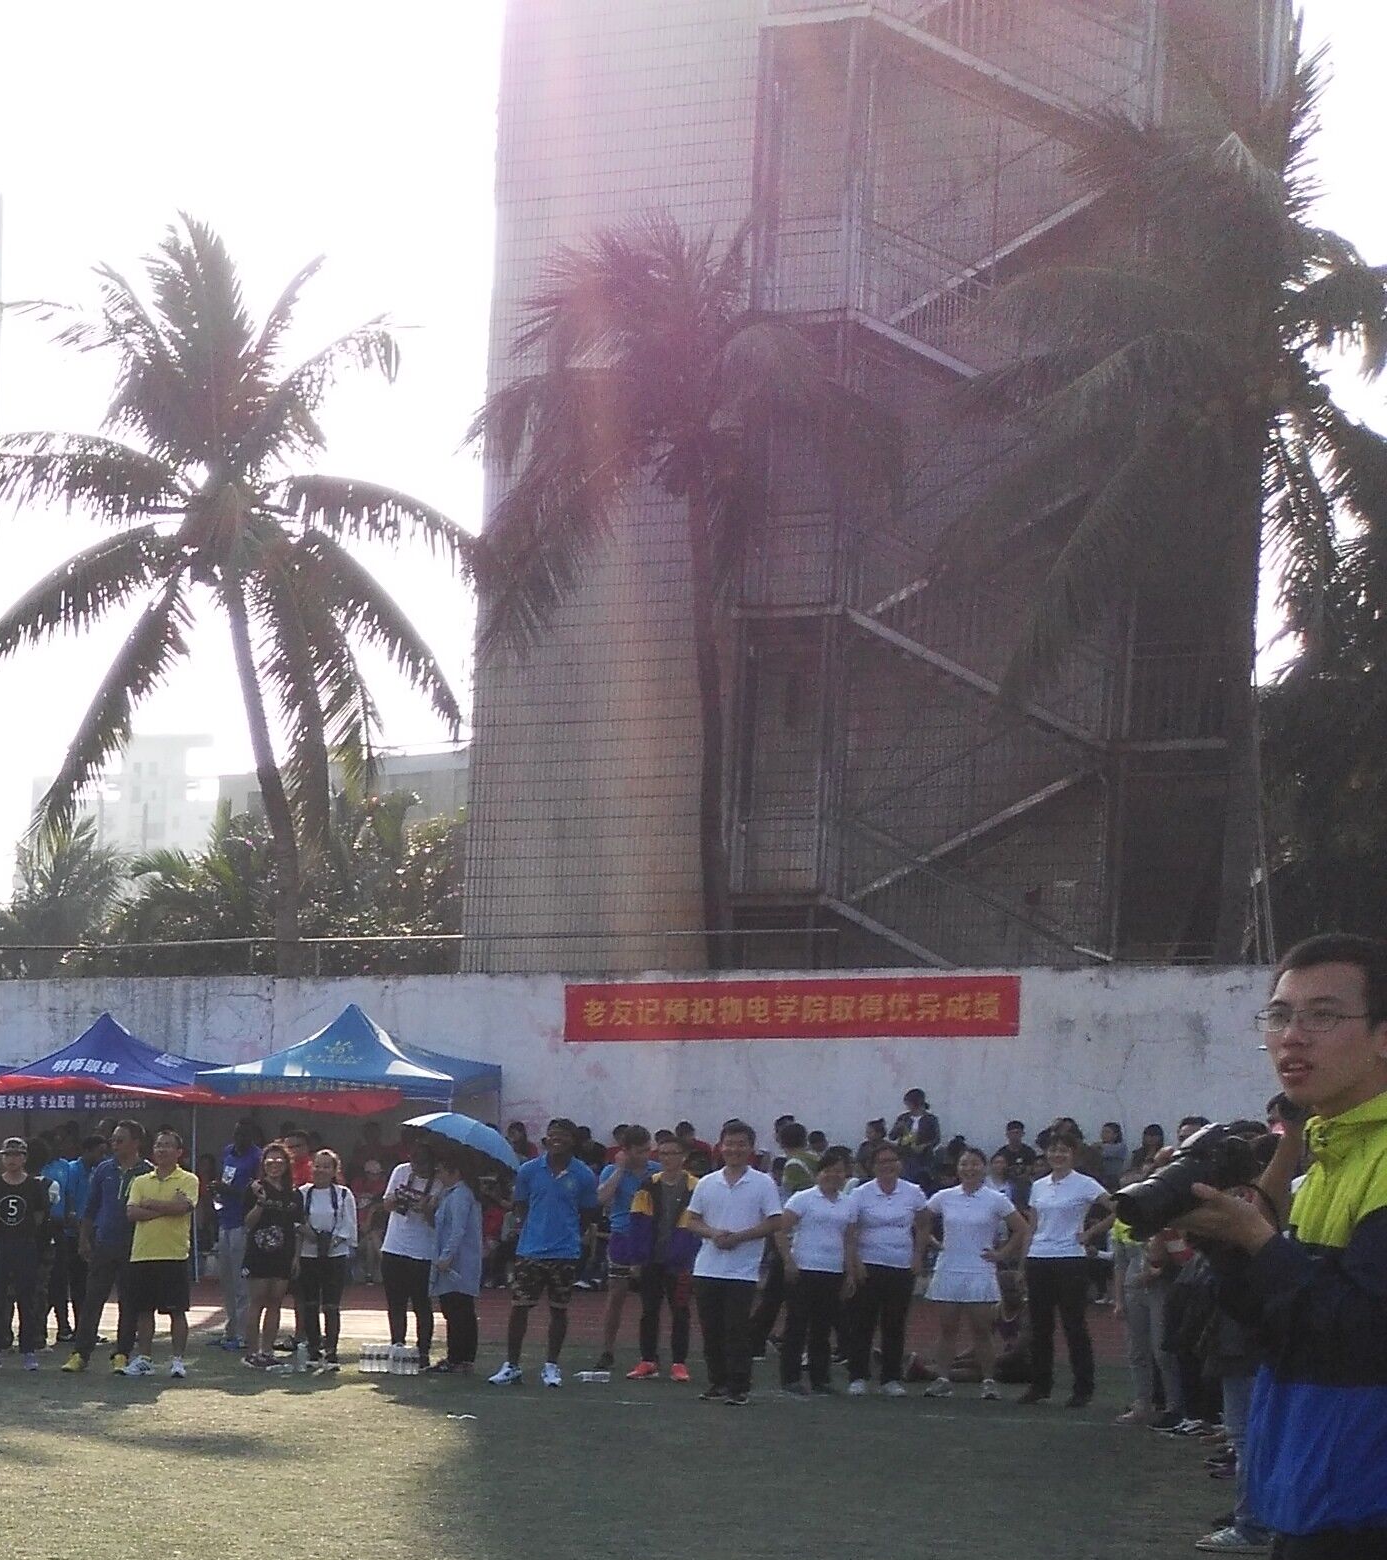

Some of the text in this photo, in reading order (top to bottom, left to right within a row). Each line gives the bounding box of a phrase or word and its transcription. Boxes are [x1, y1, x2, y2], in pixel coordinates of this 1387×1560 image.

[583, 993, 1001, 1026] 老友记预祝物电学院取得优异成绩
[51, 1058, 119, 1074] 明师眼镜
[7, 1199, 18, 1217] 5
